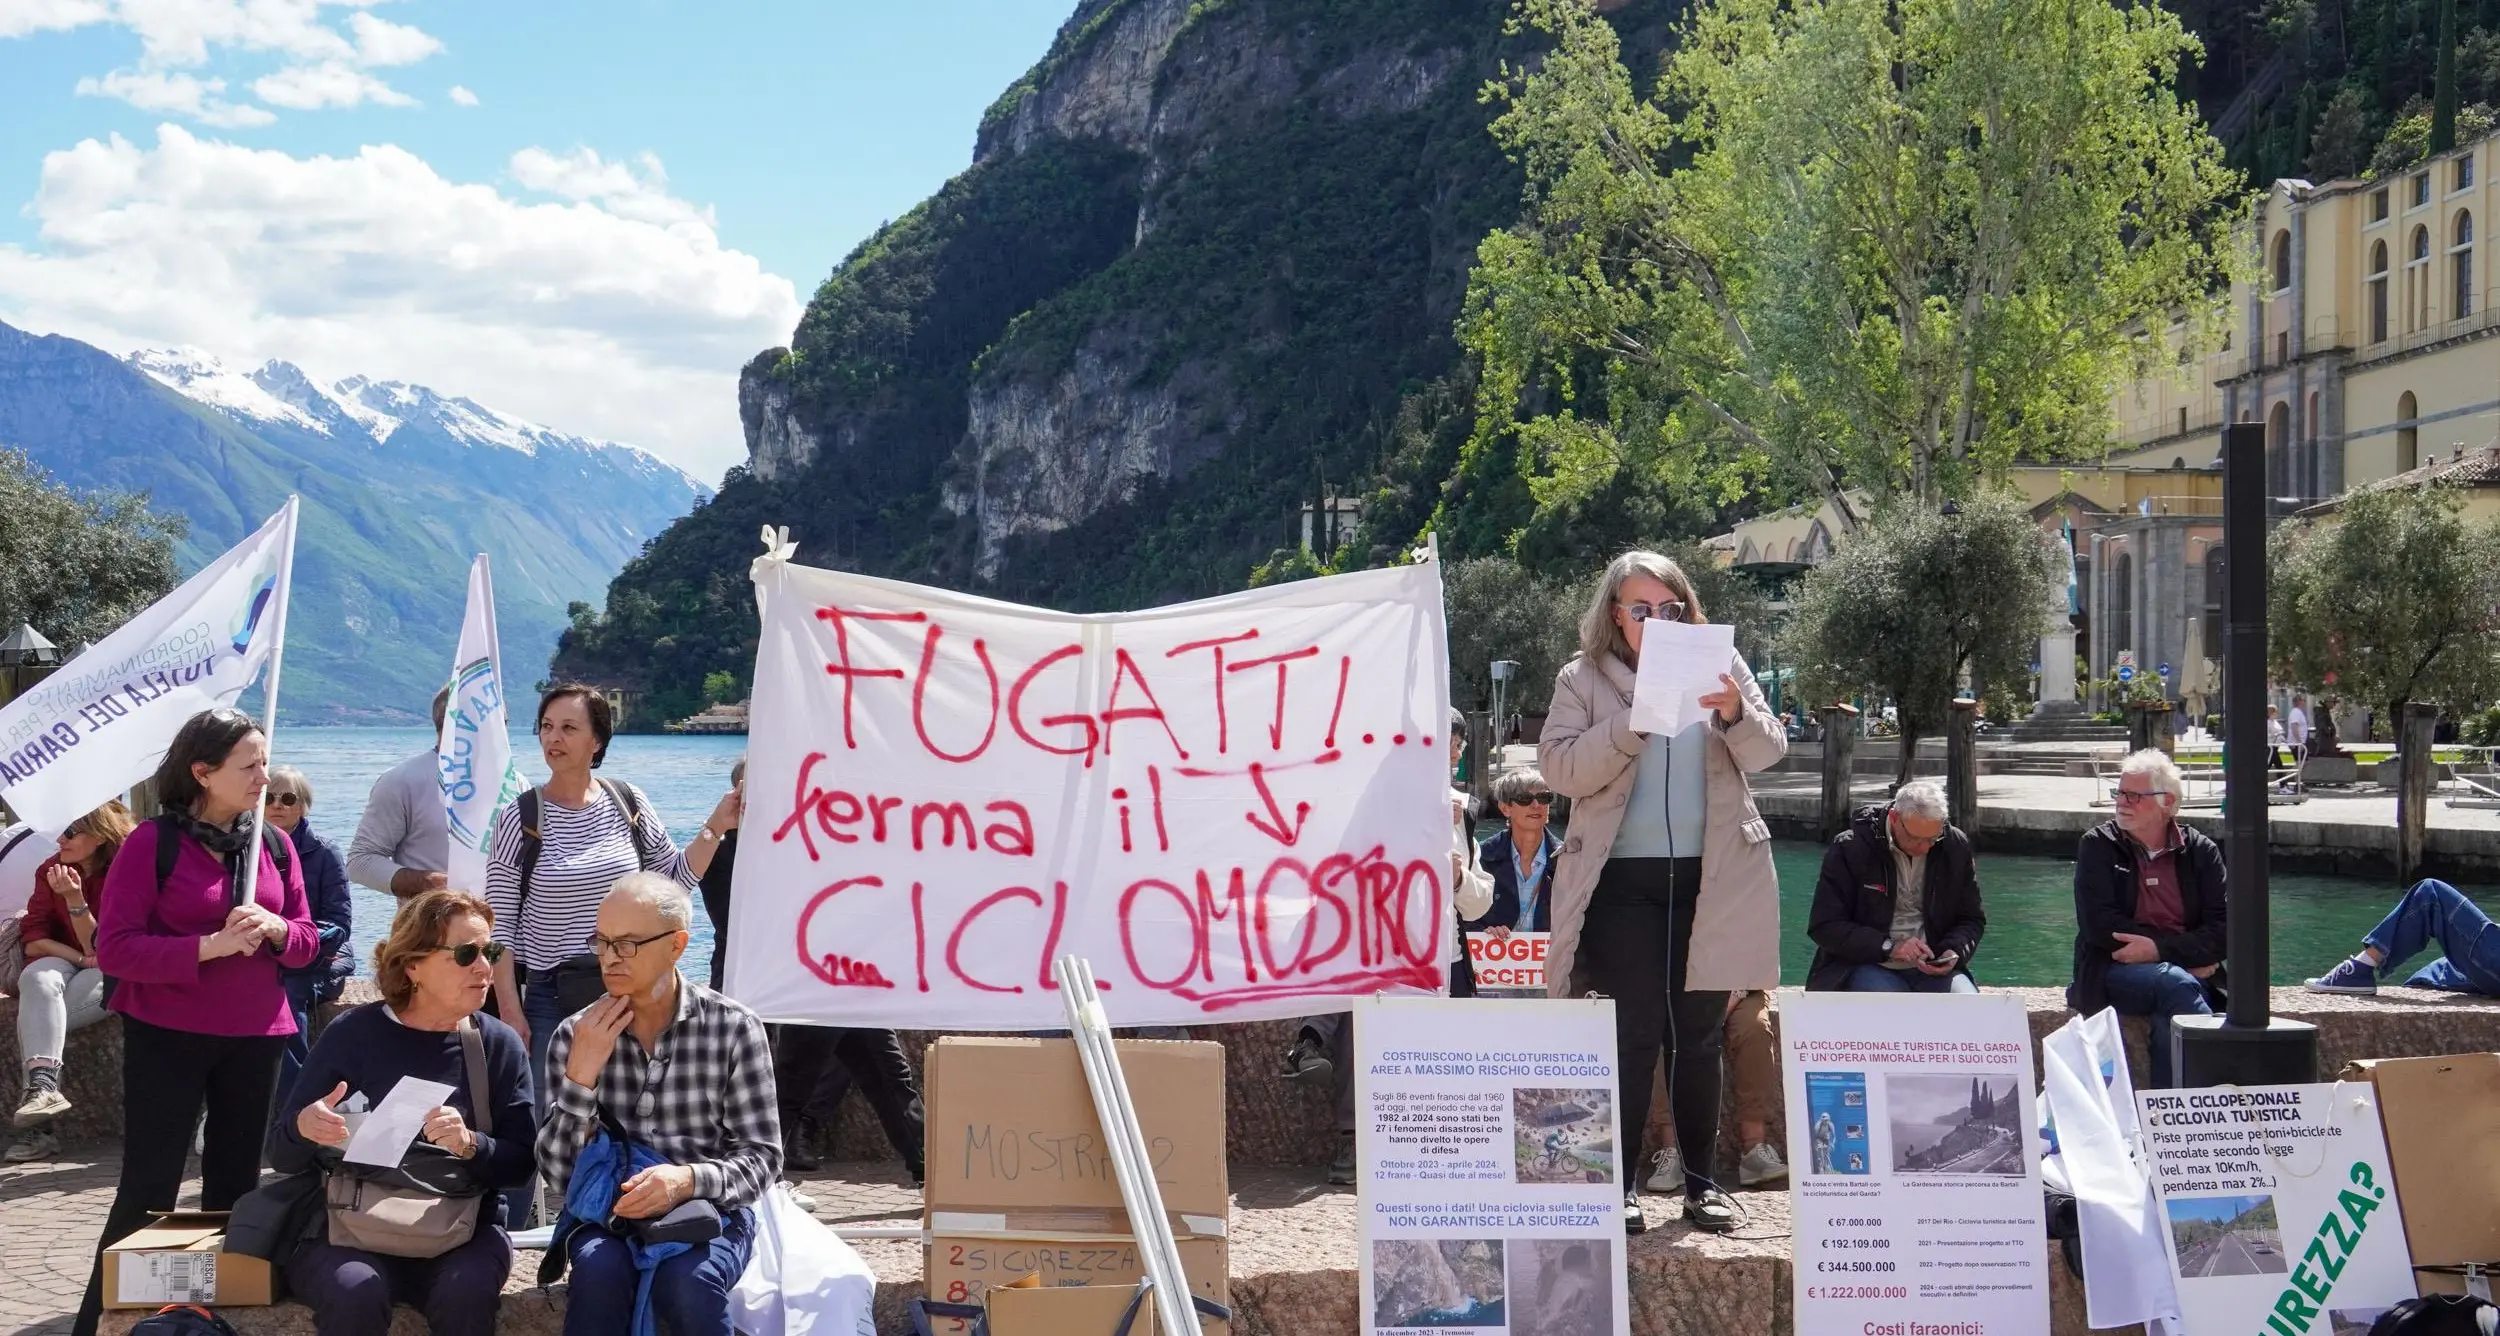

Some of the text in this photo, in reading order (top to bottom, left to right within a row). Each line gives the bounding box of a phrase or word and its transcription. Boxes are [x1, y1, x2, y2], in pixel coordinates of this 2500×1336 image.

[772, 751, 1170, 862] ferma il
[798, 844, 1442, 994] CICLOMOSTRO
[1467, 938, 1551, 961] ROGE
[1794, 1041, 2021, 1052] LA CICLOPEDONALE TURISTICA DEL GARDA
[1383, 1052, 1598, 1063] COSTRUISCONO LA CICLOTURISTICA IN
[1800, 1053, 2017, 1064] E' UN'OPERA IMMORALE PER SUOI COSTI
[1371, 1065, 1610, 1077] AREE A MASSIMO RISCHIO GEOLOGICO
[1373, 1092, 1394, 1102] Sugli
[1409, 1092, 1434, 1101] eventi
[1437, 1092, 1466, 1101] franosi
[1468, 1093, 1481, 1101] dal
[1484, 1093, 1504, 1101] 1960
[1411, 1103, 1424, 1111] nel
[1426, 1103, 1459, 1114] periodo
[1462, 1103, 1475, 1112] che
[1490, 1103, 1503, 1112] dal
[2146, 1097, 2185, 1111] PISTA
[1378, 1114, 1399, 1122] 1982
[1402, 1114, 1410, 1122] al
[1412, 1114, 1433, 1122] 2024
[1461, 1114, 1481, 1122] stati
[2163, 1113, 2227, 1126] CICLOVIA
[1394, 1125, 1436, 1133] fenomeni
[1439, 1125, 1484, 1133] disastrosi
[1486, 1125, 1503, 1133] che
[1421, 1136, 1451, 1144] divelto
[1464, 1137, 1490, 1145] opere
[2153, 1132, 2182, 1144] Piste
[2186, 1130, 2244, 1145] promiscue
[1421, 1146, 1459, 1154] di difesa
[2157, 1147, 2209, 1160] vincolate
[2213, 1145, 2260, 1157] secondo
[1152, 1136, 1177, 1184] 2
[1381, 1160, 1473, 1170] Ottobre 2023 aprile
[2159, 1161, 2262, 1177] (vel. max 10Km/h,
[1388, 1171, 1411, 1179] frane
[1420, 1171, 1446, 1180] Quasi
[1449, 1171, 1465, 1179] due
[1468, 1171, 1476, 1179] al
[1479, 1172, 1506, 1180] mese!
[2163, 1179, 2218, 1195] pendenza
[2222, 1178, 2246, 1189] max
[1376, 1203, 1611, 1214] Questi sono dati! Una ciclovia sulle falesie
[1389, 1216, 1599, 1227] NON GARANTISCE LA SICUREZZA
[1836, 1219, 1881, 1227] 67.000.000
[1822, 1239, 1890, 1249] € 192.109.000
[1980, 1240, 2003, 1248] progetto
[950, 1245, 1134, 1274] 2 SICUREZZA
[204, 1253, 214, 1285] BRESCIA
[1818, 1262, 1895, 1272] € 344.500.000
[947, 1280, 968, 1303] 8
[1808, 1287, 1906, 1299] € 1.222.000.000
[1864, 1321, 1984, 1336] Costi faraonici:
